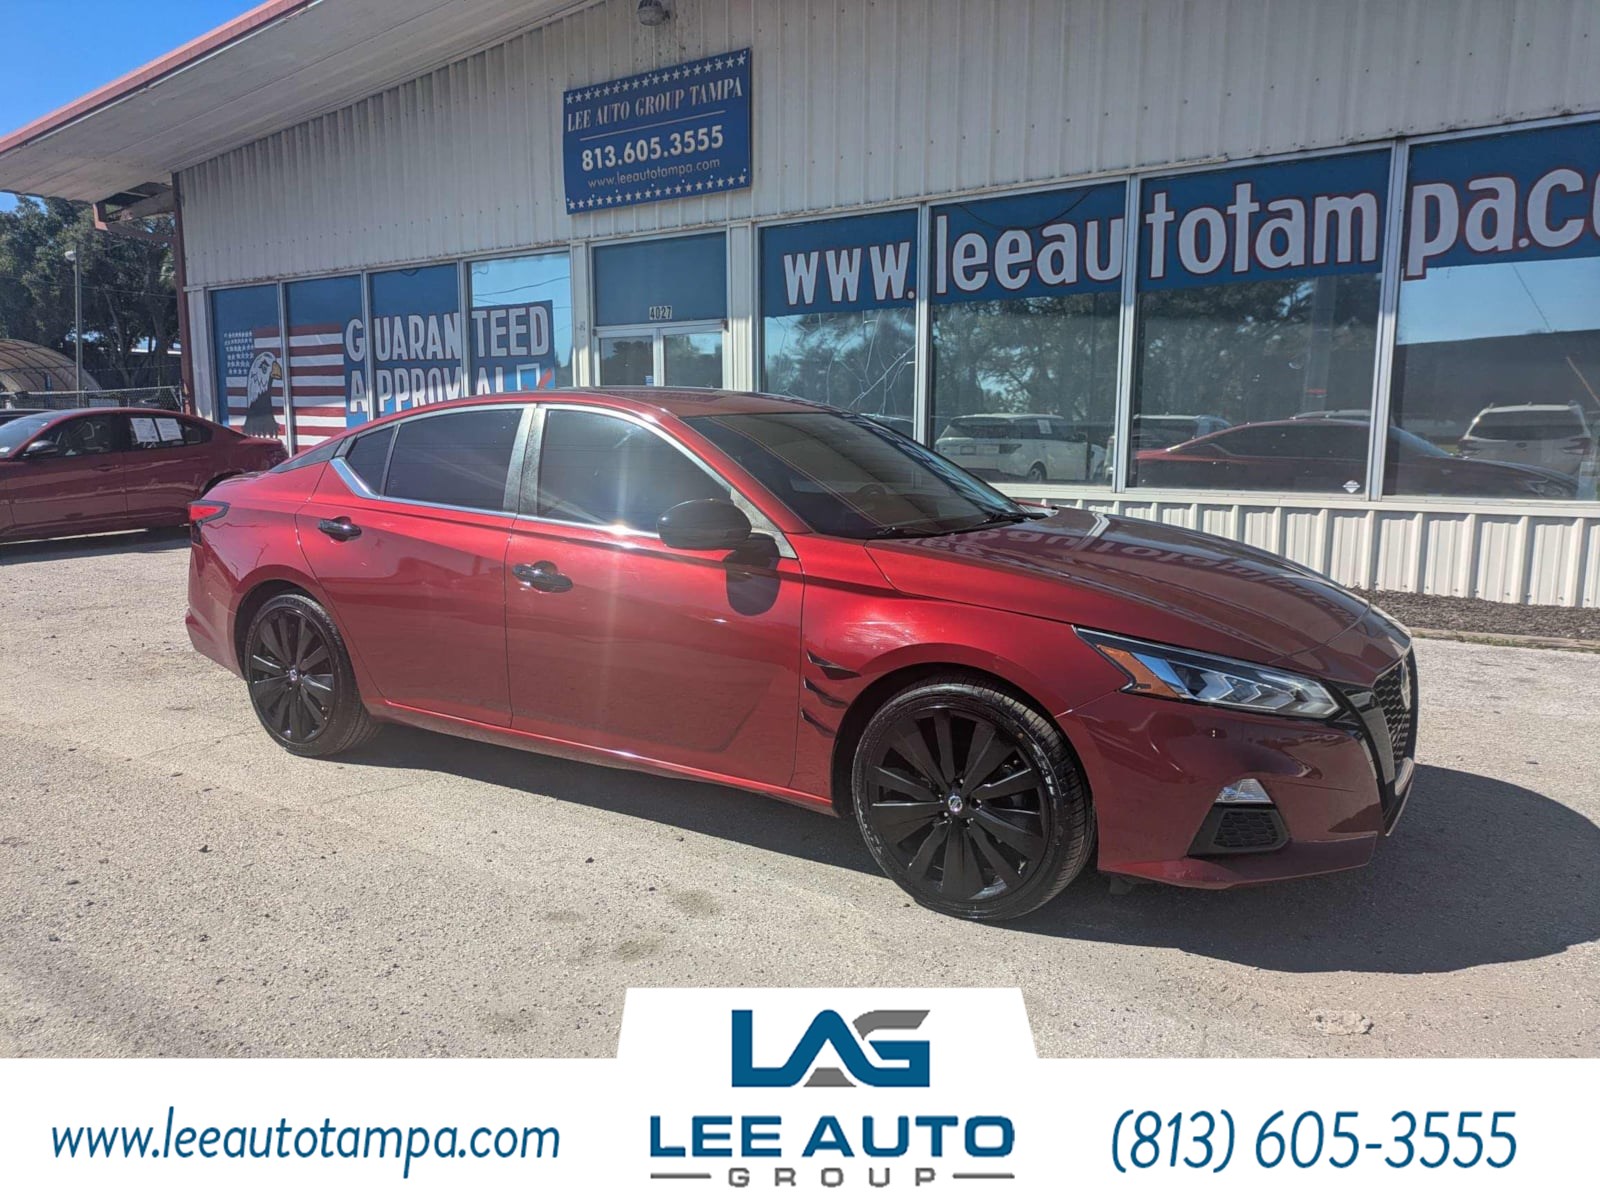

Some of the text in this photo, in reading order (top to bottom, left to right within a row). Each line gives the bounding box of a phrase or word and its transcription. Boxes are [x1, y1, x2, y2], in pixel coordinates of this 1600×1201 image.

[567, 76, 743, 132] LEE AUTO GROUP TAMPA
[581, 124, 724, 172] 813.605.3555
[587, 158, 721, 189] www.leeautotampa.com
[783, 167, 1600, 306] www.leeautotampa.c
[345, 305, 551, 363] GUARANTEED
[649, 305, 673, 321] 4027
